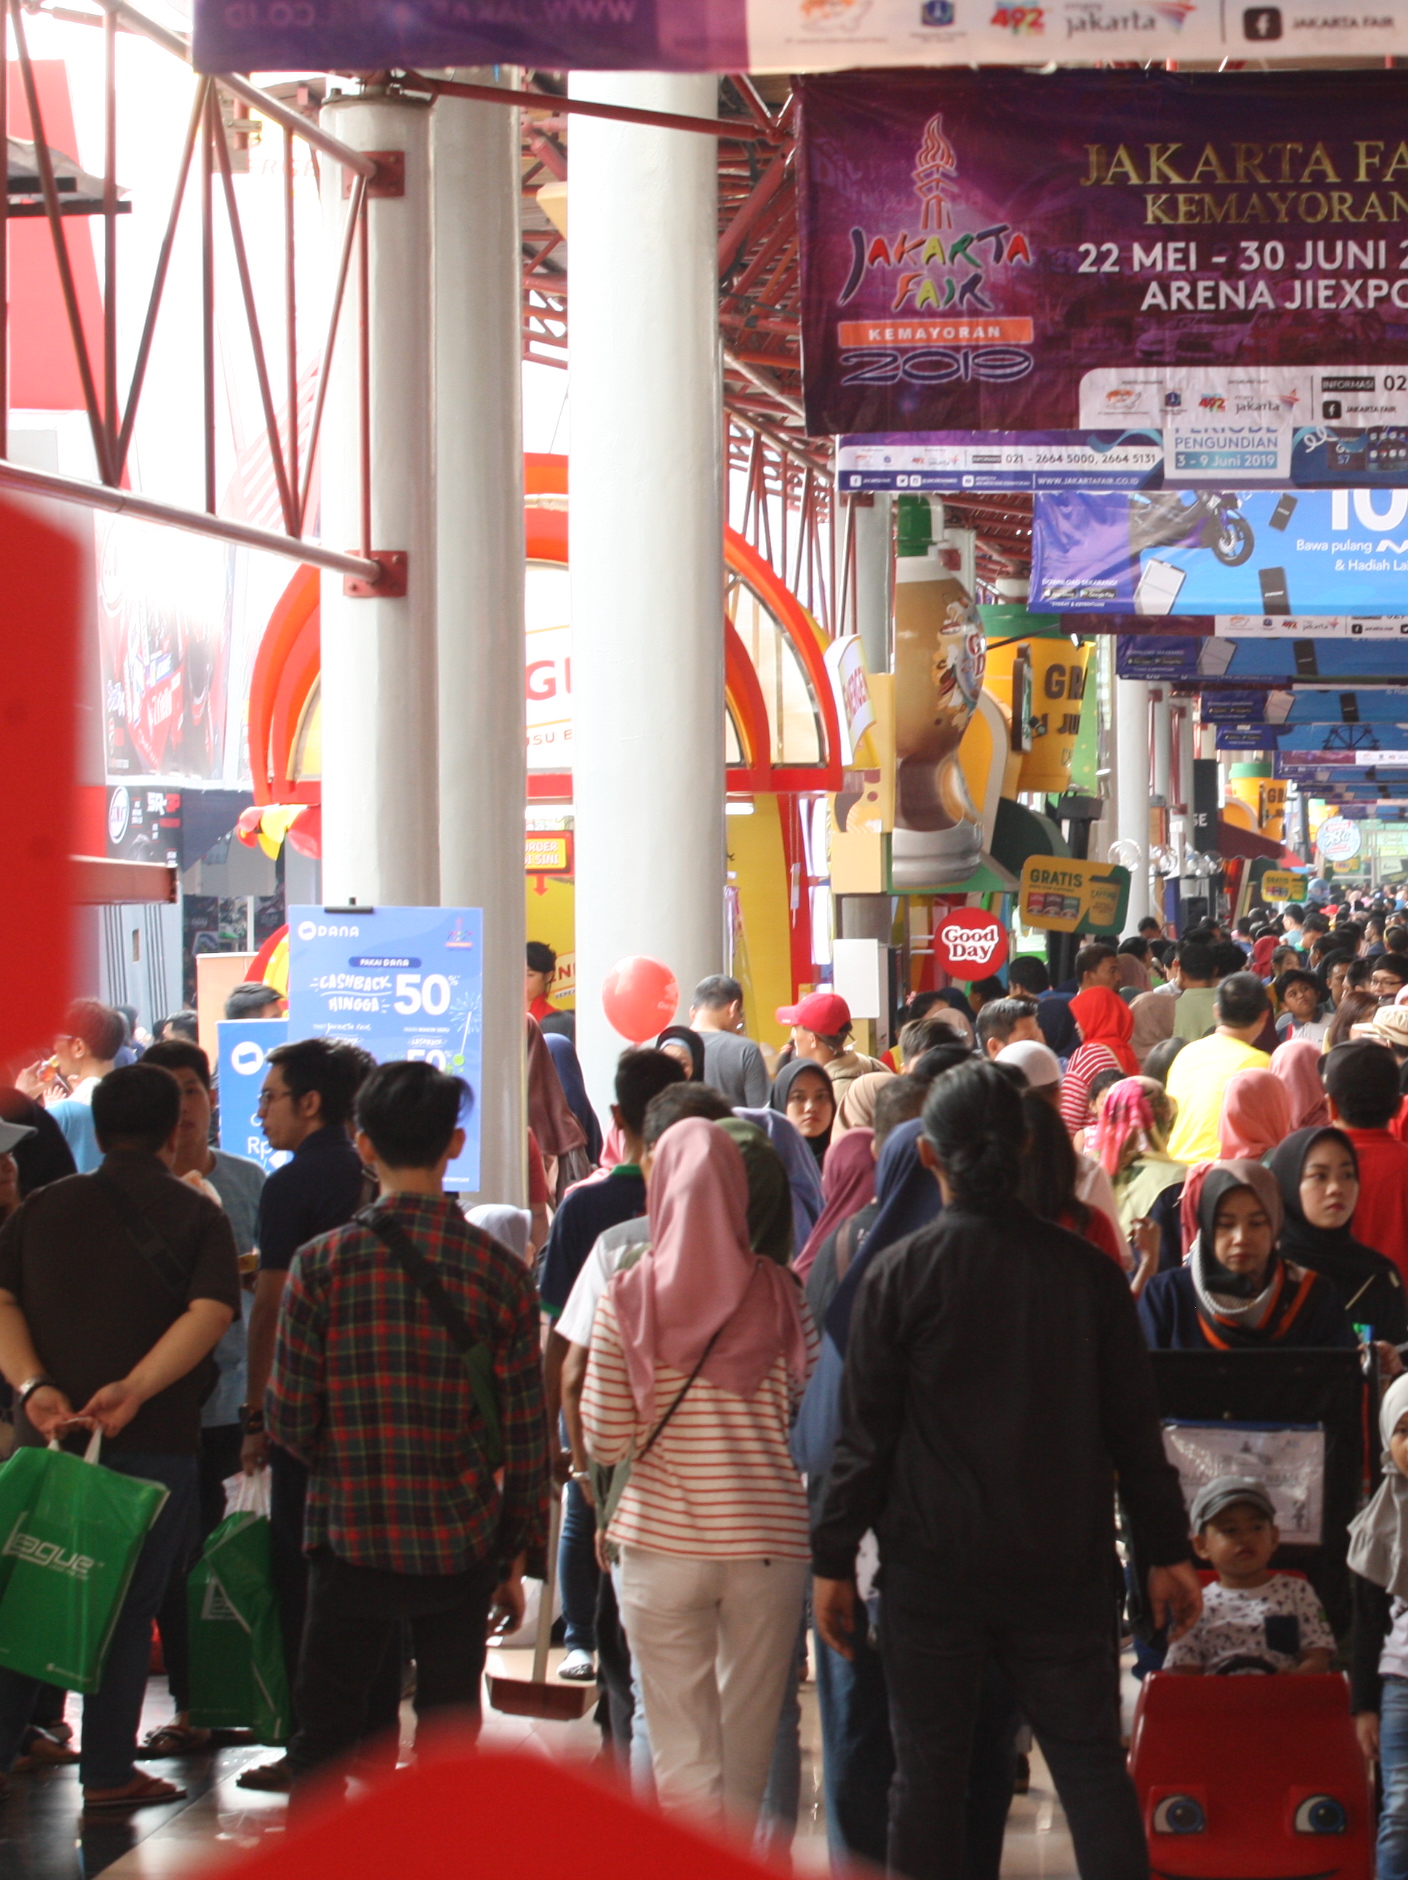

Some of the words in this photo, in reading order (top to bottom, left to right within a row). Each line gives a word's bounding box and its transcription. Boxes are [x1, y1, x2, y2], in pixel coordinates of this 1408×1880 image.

[1066, 9, 1157, 37] jakarta
[1292, 15, 1359, 30] JAKARTA
[1362, 15, 1396, 29] FAIR
[1079, 140, 1343, 187] JAKARTA
[1077, 242, 1120, 274] 22
[1132, 241, 1198, 273] MEI
[1239, 240, 1286, 272] 30
[1295, 239, 1387, 272] JUNI
[837, 223, 1033, 308] JAKARTA
[891, 271, 995, 312] FAIR
[1140, 280, 1276, 311] ARENA
[868, 325, 1001, 342] KEMAYORAN
[840, 347, 1033, 386] 2019
[1321, 377, 1375, 392] INFORMASI
[1234, 400, 1280, 415] jakarta
[1175, 436, 1278, 450] PENGUNDIAN
[1006, 454, 1024, 464] 021
[1036, 453, 1063, 464] 2664
[1102, 453, 1129, 464] 2664
[1133, 453, 1156, 463] 5131
[1177, 455, 1186, 467] 3
[1200, 455, 1210, 467] 9
[1213, 455, 1240, 467] Juni
[1244, 455, 1276, 468] 2019
[1296, 539, 1329, 551] Bawa
[1331, 539, 1373, 555] pulang
[1335, 559, 1345, 572] &
[1348, 558, 1391, 572] Hadiah
[1030, 868, 1083, 888] GRATIS
[317, 925, 360, 938] DANA
[942, 925, 999, 944] Good
[950, 942, 995, 962] Day
[319, 973, 393, 991] CASHBACK
[328, 996, 381, 1013] HINGGA
